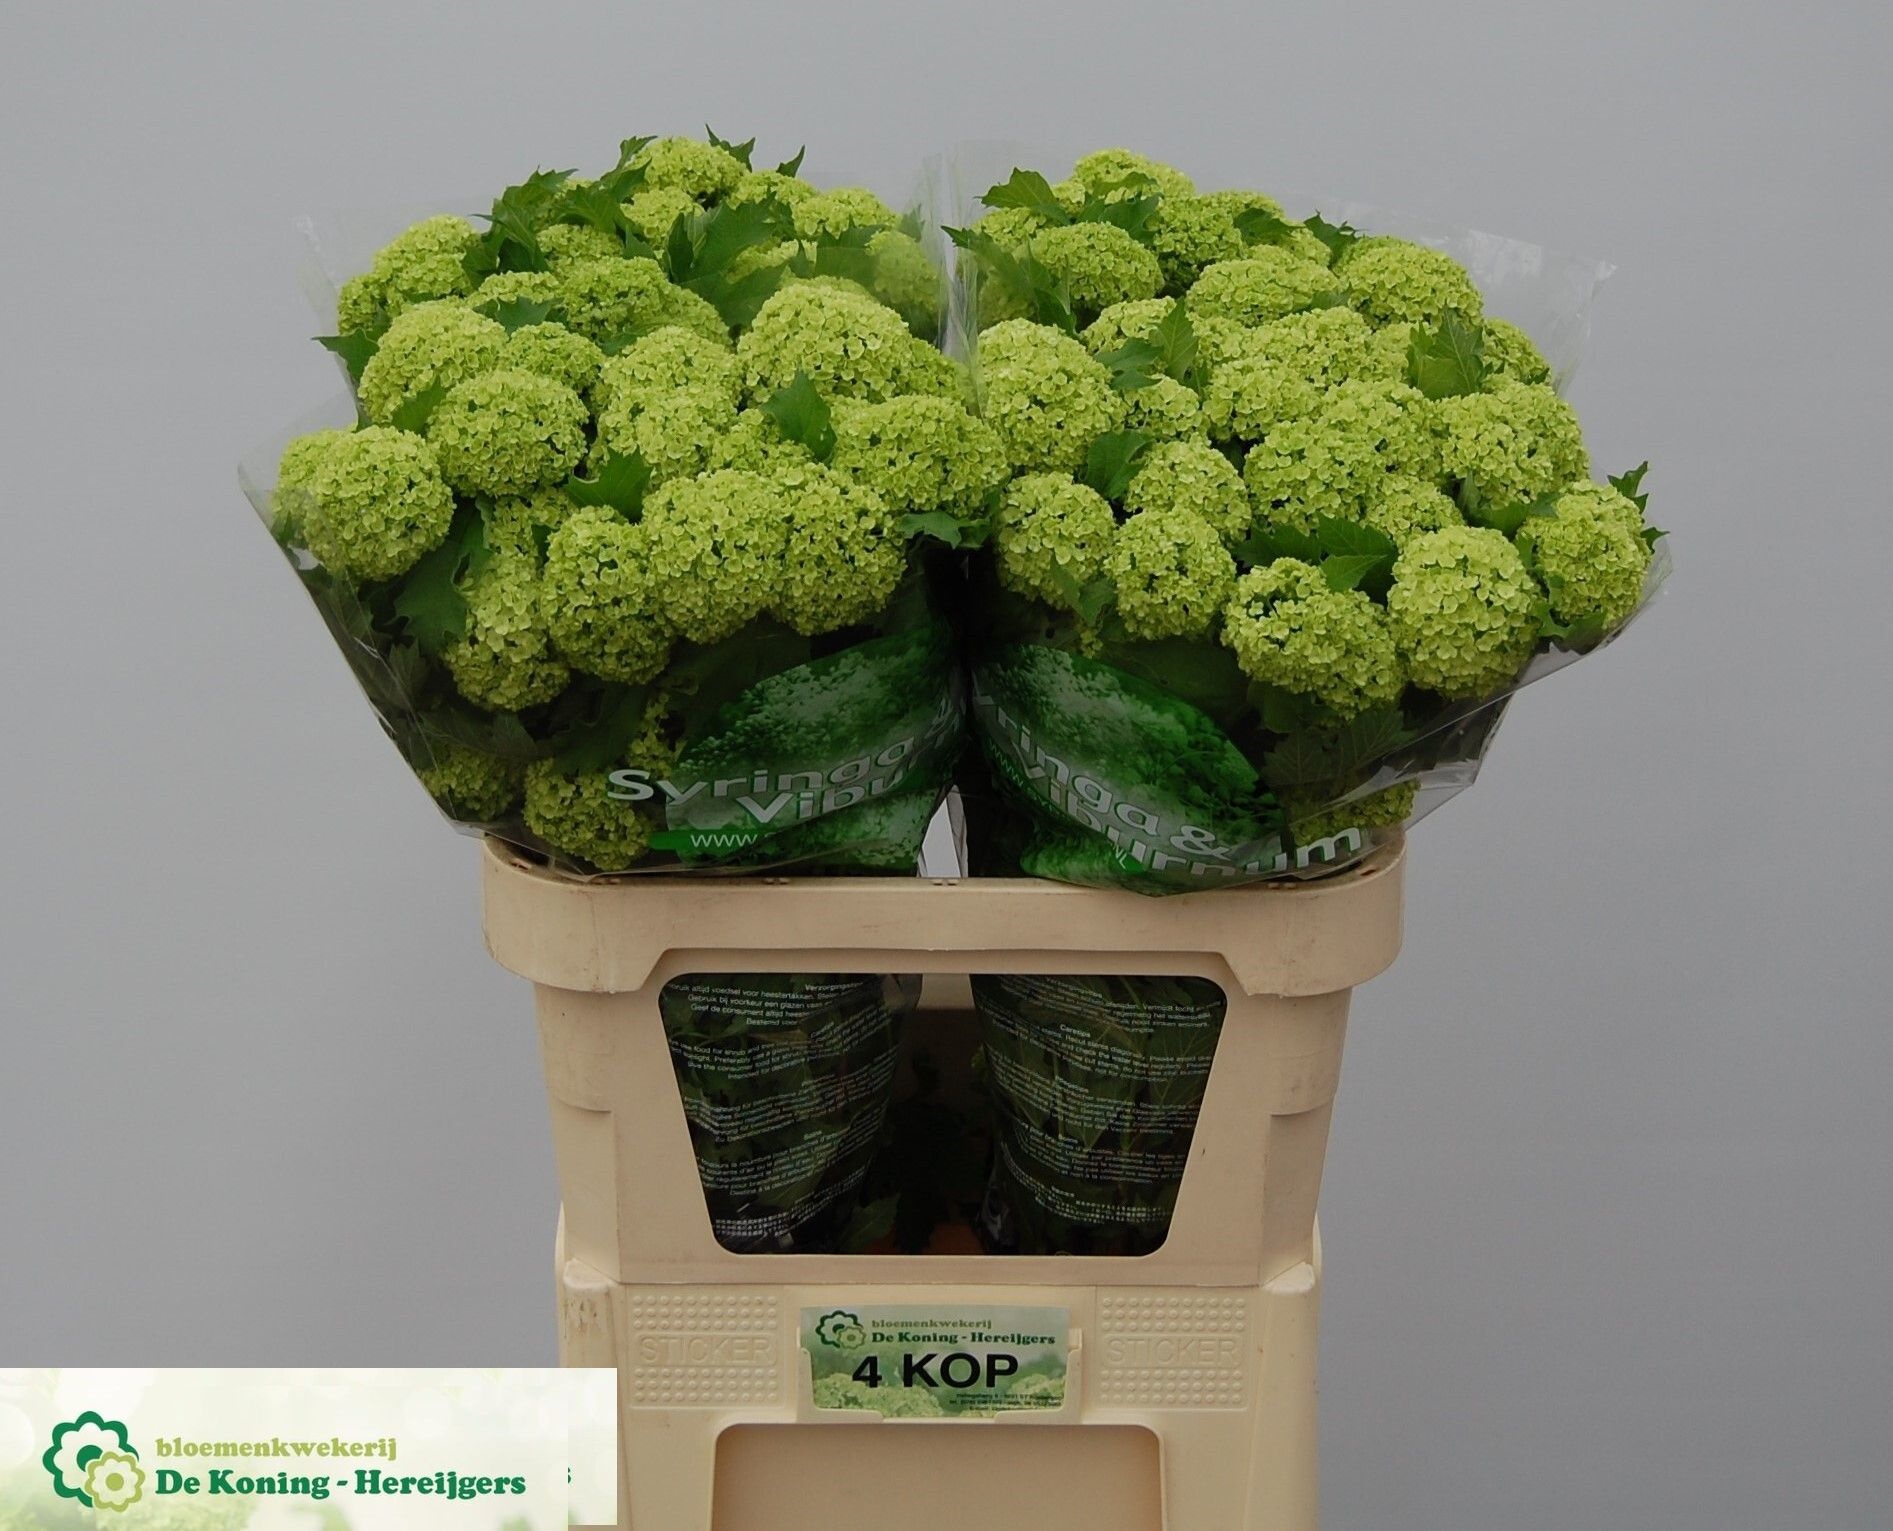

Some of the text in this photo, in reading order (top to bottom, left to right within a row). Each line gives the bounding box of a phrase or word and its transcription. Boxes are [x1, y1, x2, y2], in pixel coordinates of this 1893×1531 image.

[607, 735, 915, 806] Syringa
[973, 693, 1161, 838] ringa
[1170, 824, 1231, 861] &
[736, 766, 907, 824] Vibu
[871, 1319, 992, 1331] bloemenkwekerij
[872, 1332, 894, 1343] De
[897, 1332, 959, 1345] Koning
[970, 1332, 1056, 1346] Hereijgers
[640, 1336, 776, 1364] STICKER
[1107, 1337, 1242, 1365] STICKER
[852, 1353, 1019, 1389] 4 KOP
